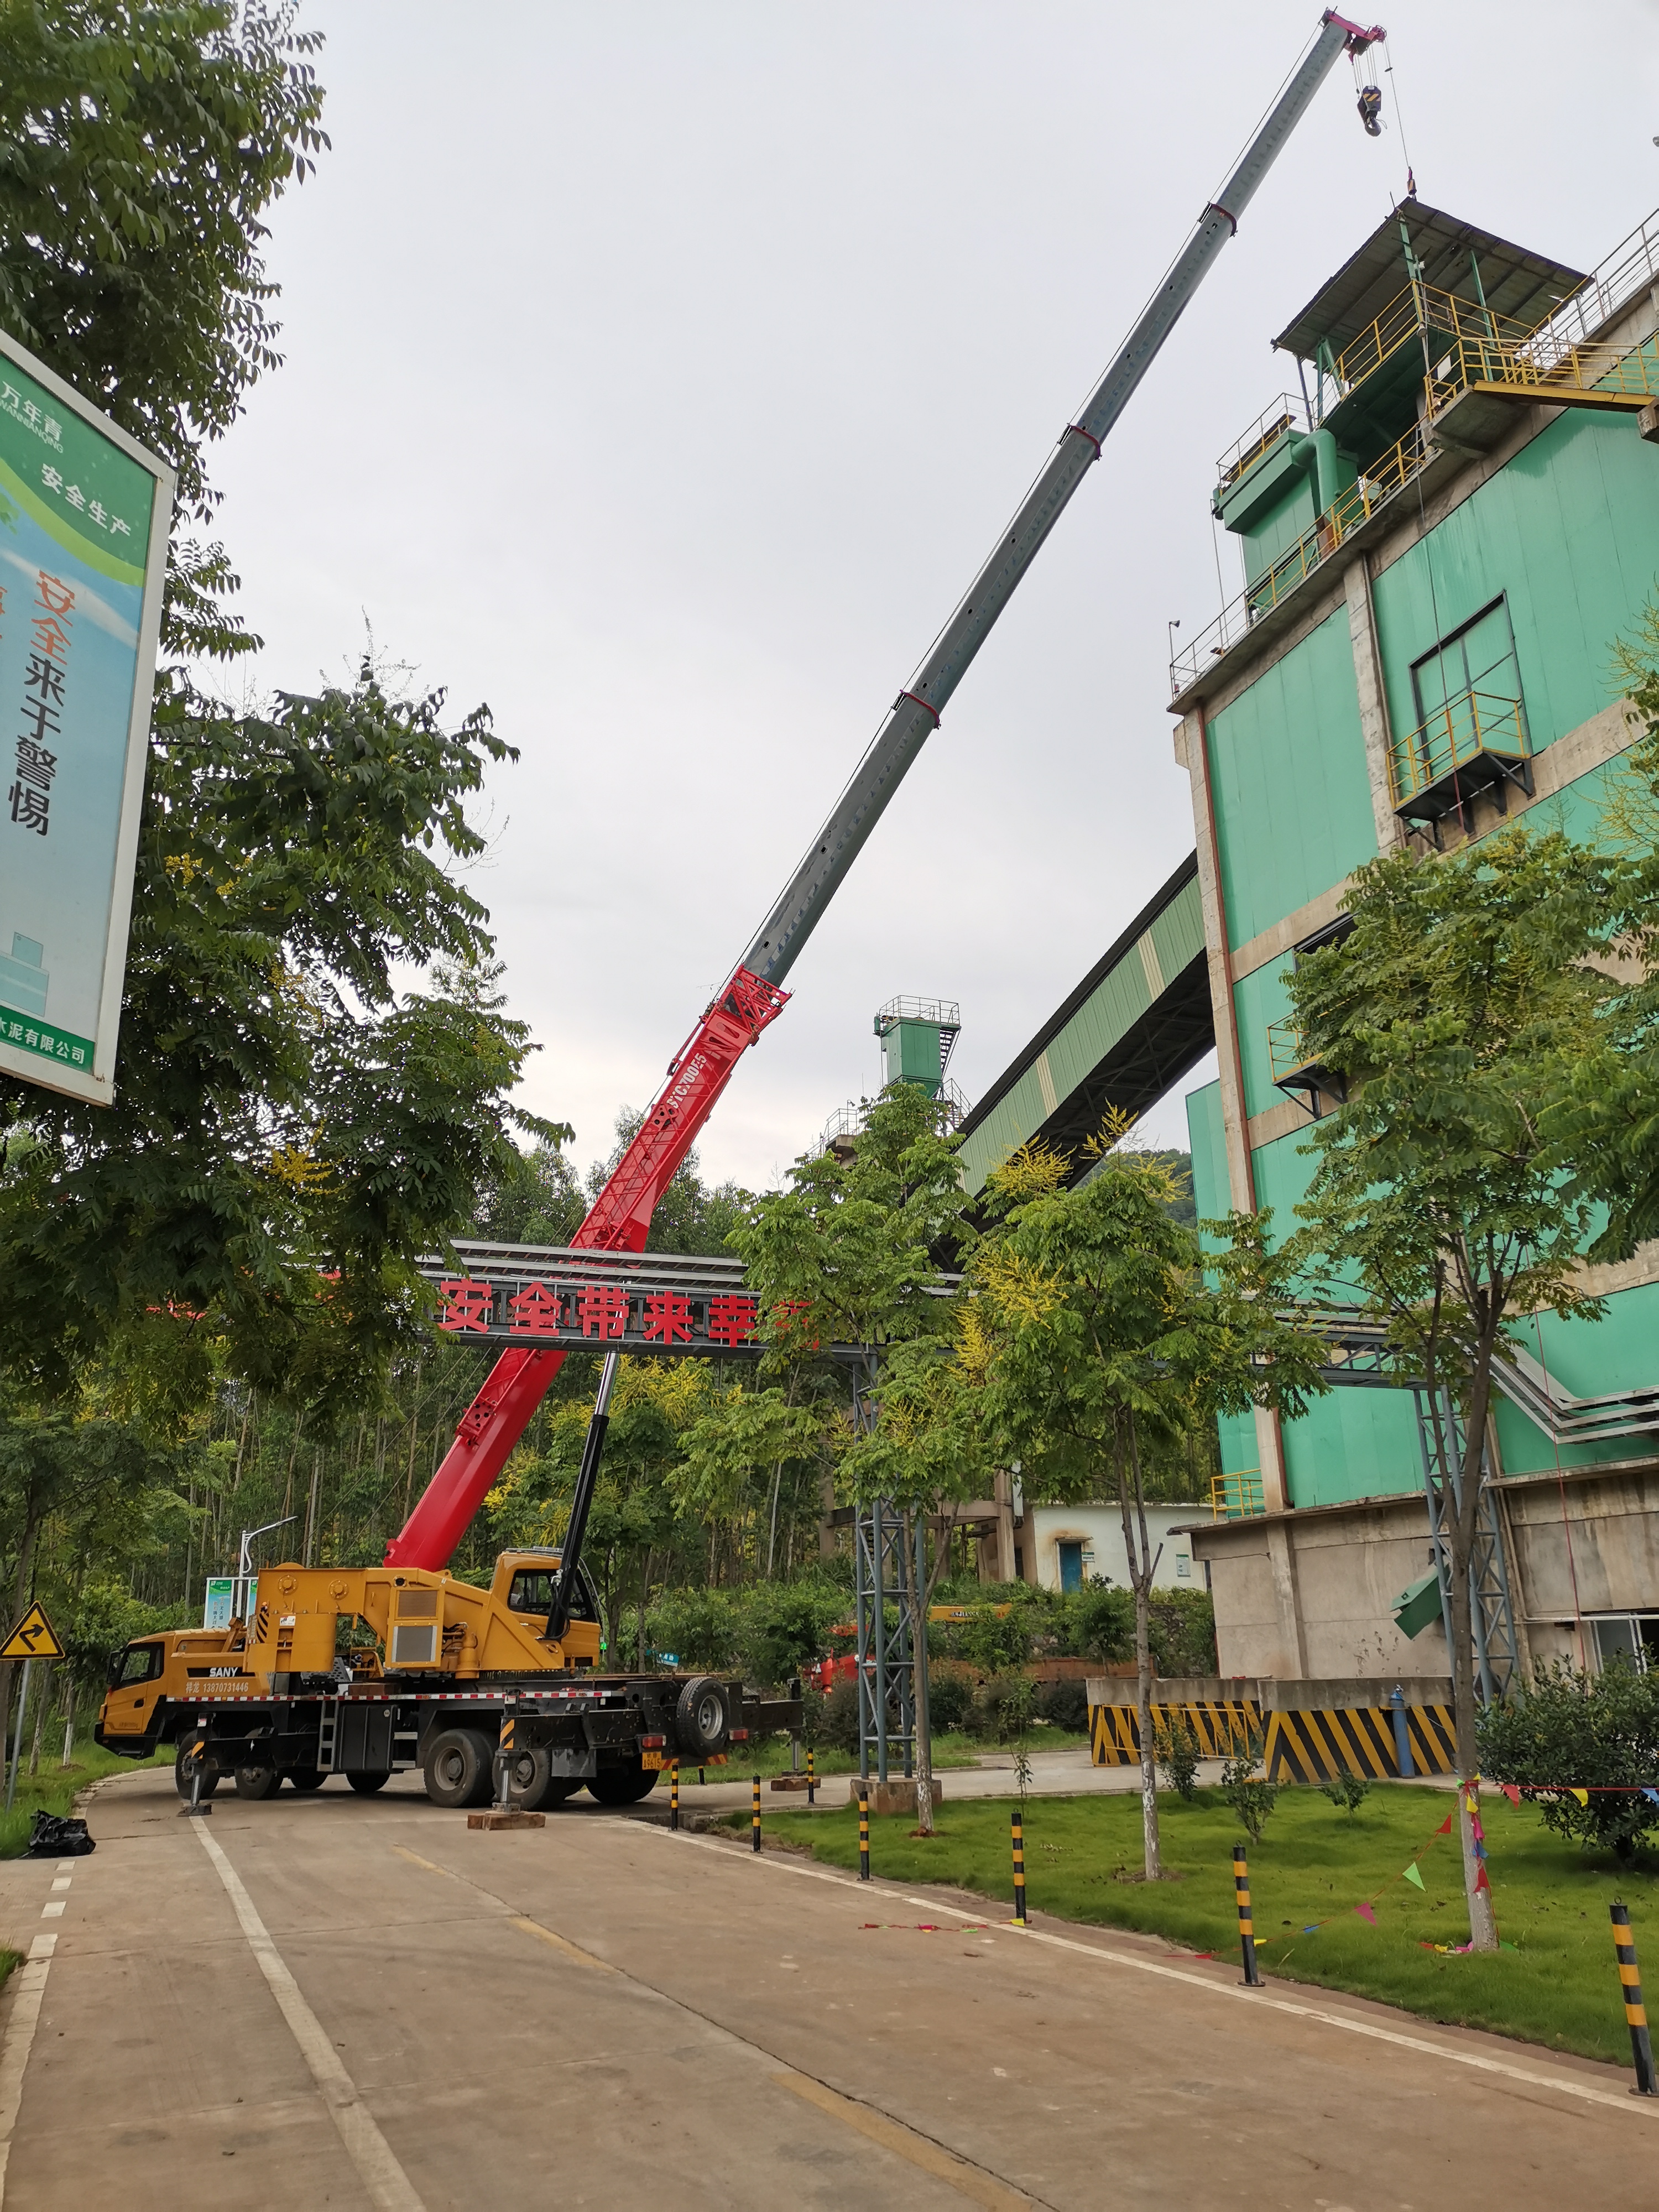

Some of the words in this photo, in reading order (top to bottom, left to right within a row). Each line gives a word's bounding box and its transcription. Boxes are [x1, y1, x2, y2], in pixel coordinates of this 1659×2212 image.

[1, 380, 63, 442] 万年青
[41, 463, 131, 536] 安全生产
[8, 569, 76, 836] 安全来于警惕
[666, 1052, 707, 1109] STC700E5
[203, 1682, 248, 1693] 13870731446
[209, 1667, 238, 1677] SANY
